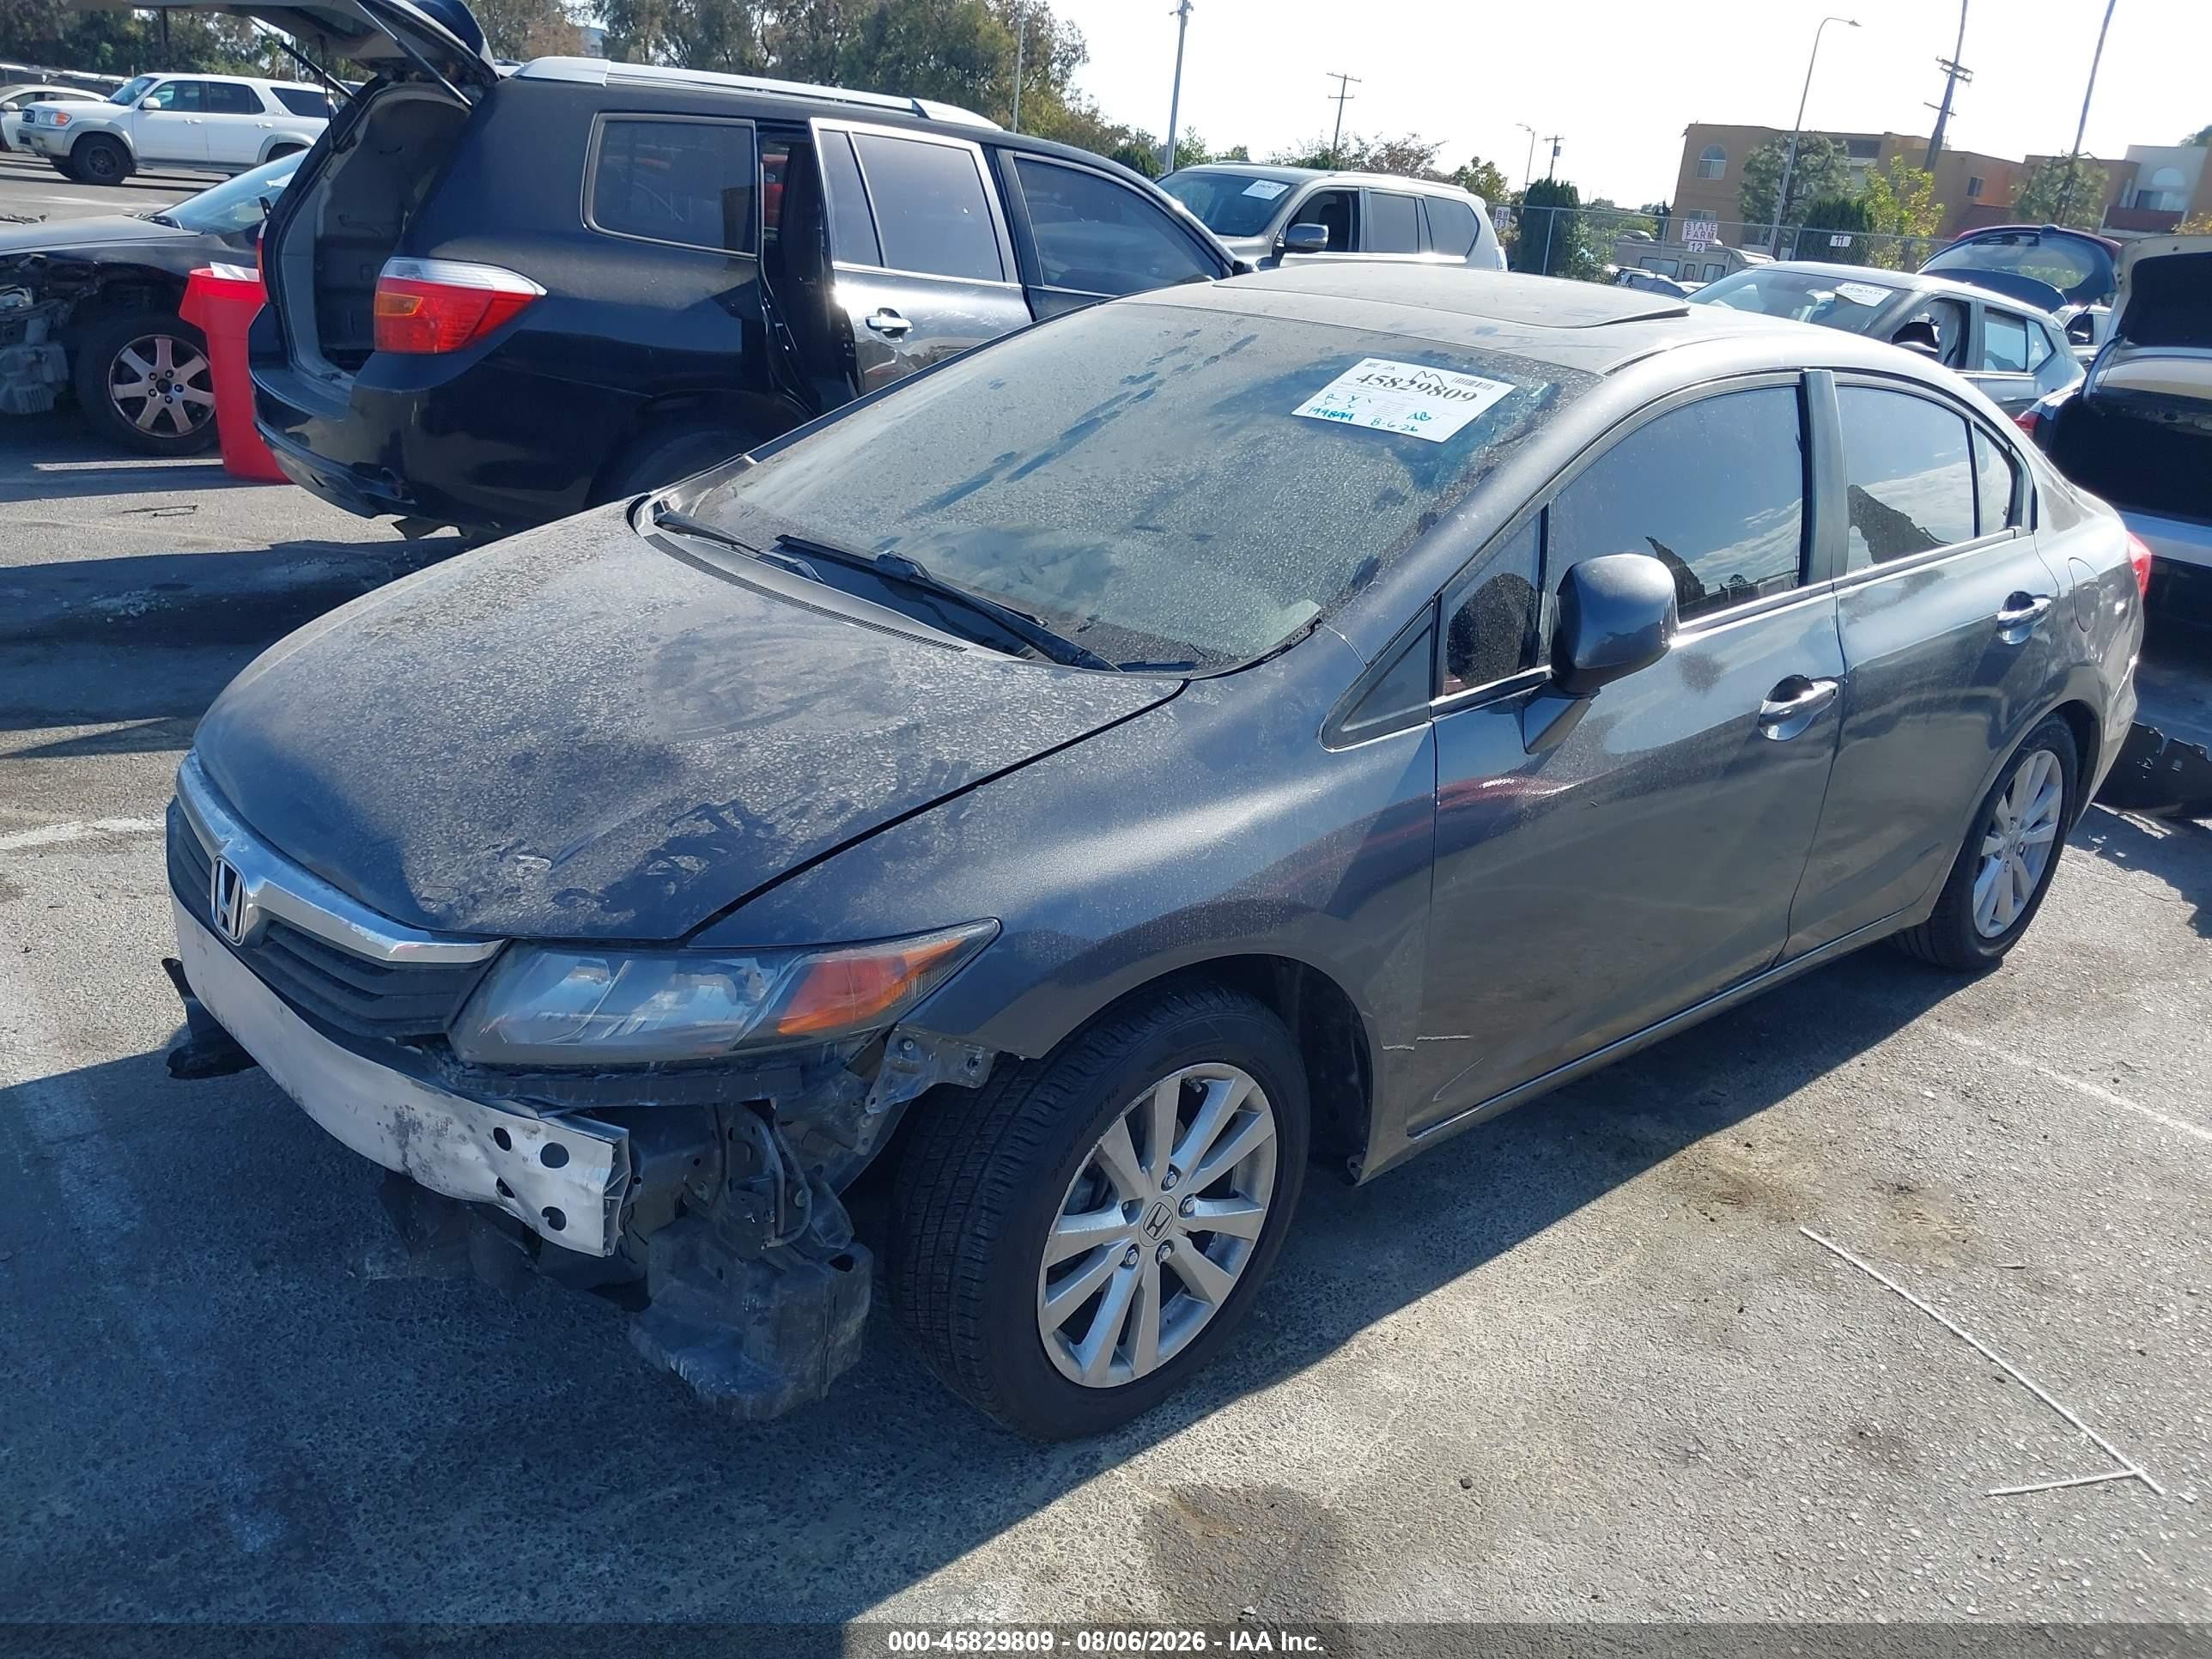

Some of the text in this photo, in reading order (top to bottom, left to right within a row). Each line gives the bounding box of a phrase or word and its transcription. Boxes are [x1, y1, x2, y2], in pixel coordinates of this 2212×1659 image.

[1497, 219, 1506, 228] 13
[1686, 222, 1717, 232] STATE
[1686, 230, 1715, 240] FARM
[1835, 236, 1844, 246] 11
[1691, 242, 1703, 252] 12
[1355, 373, 1478, 402] 45829809
